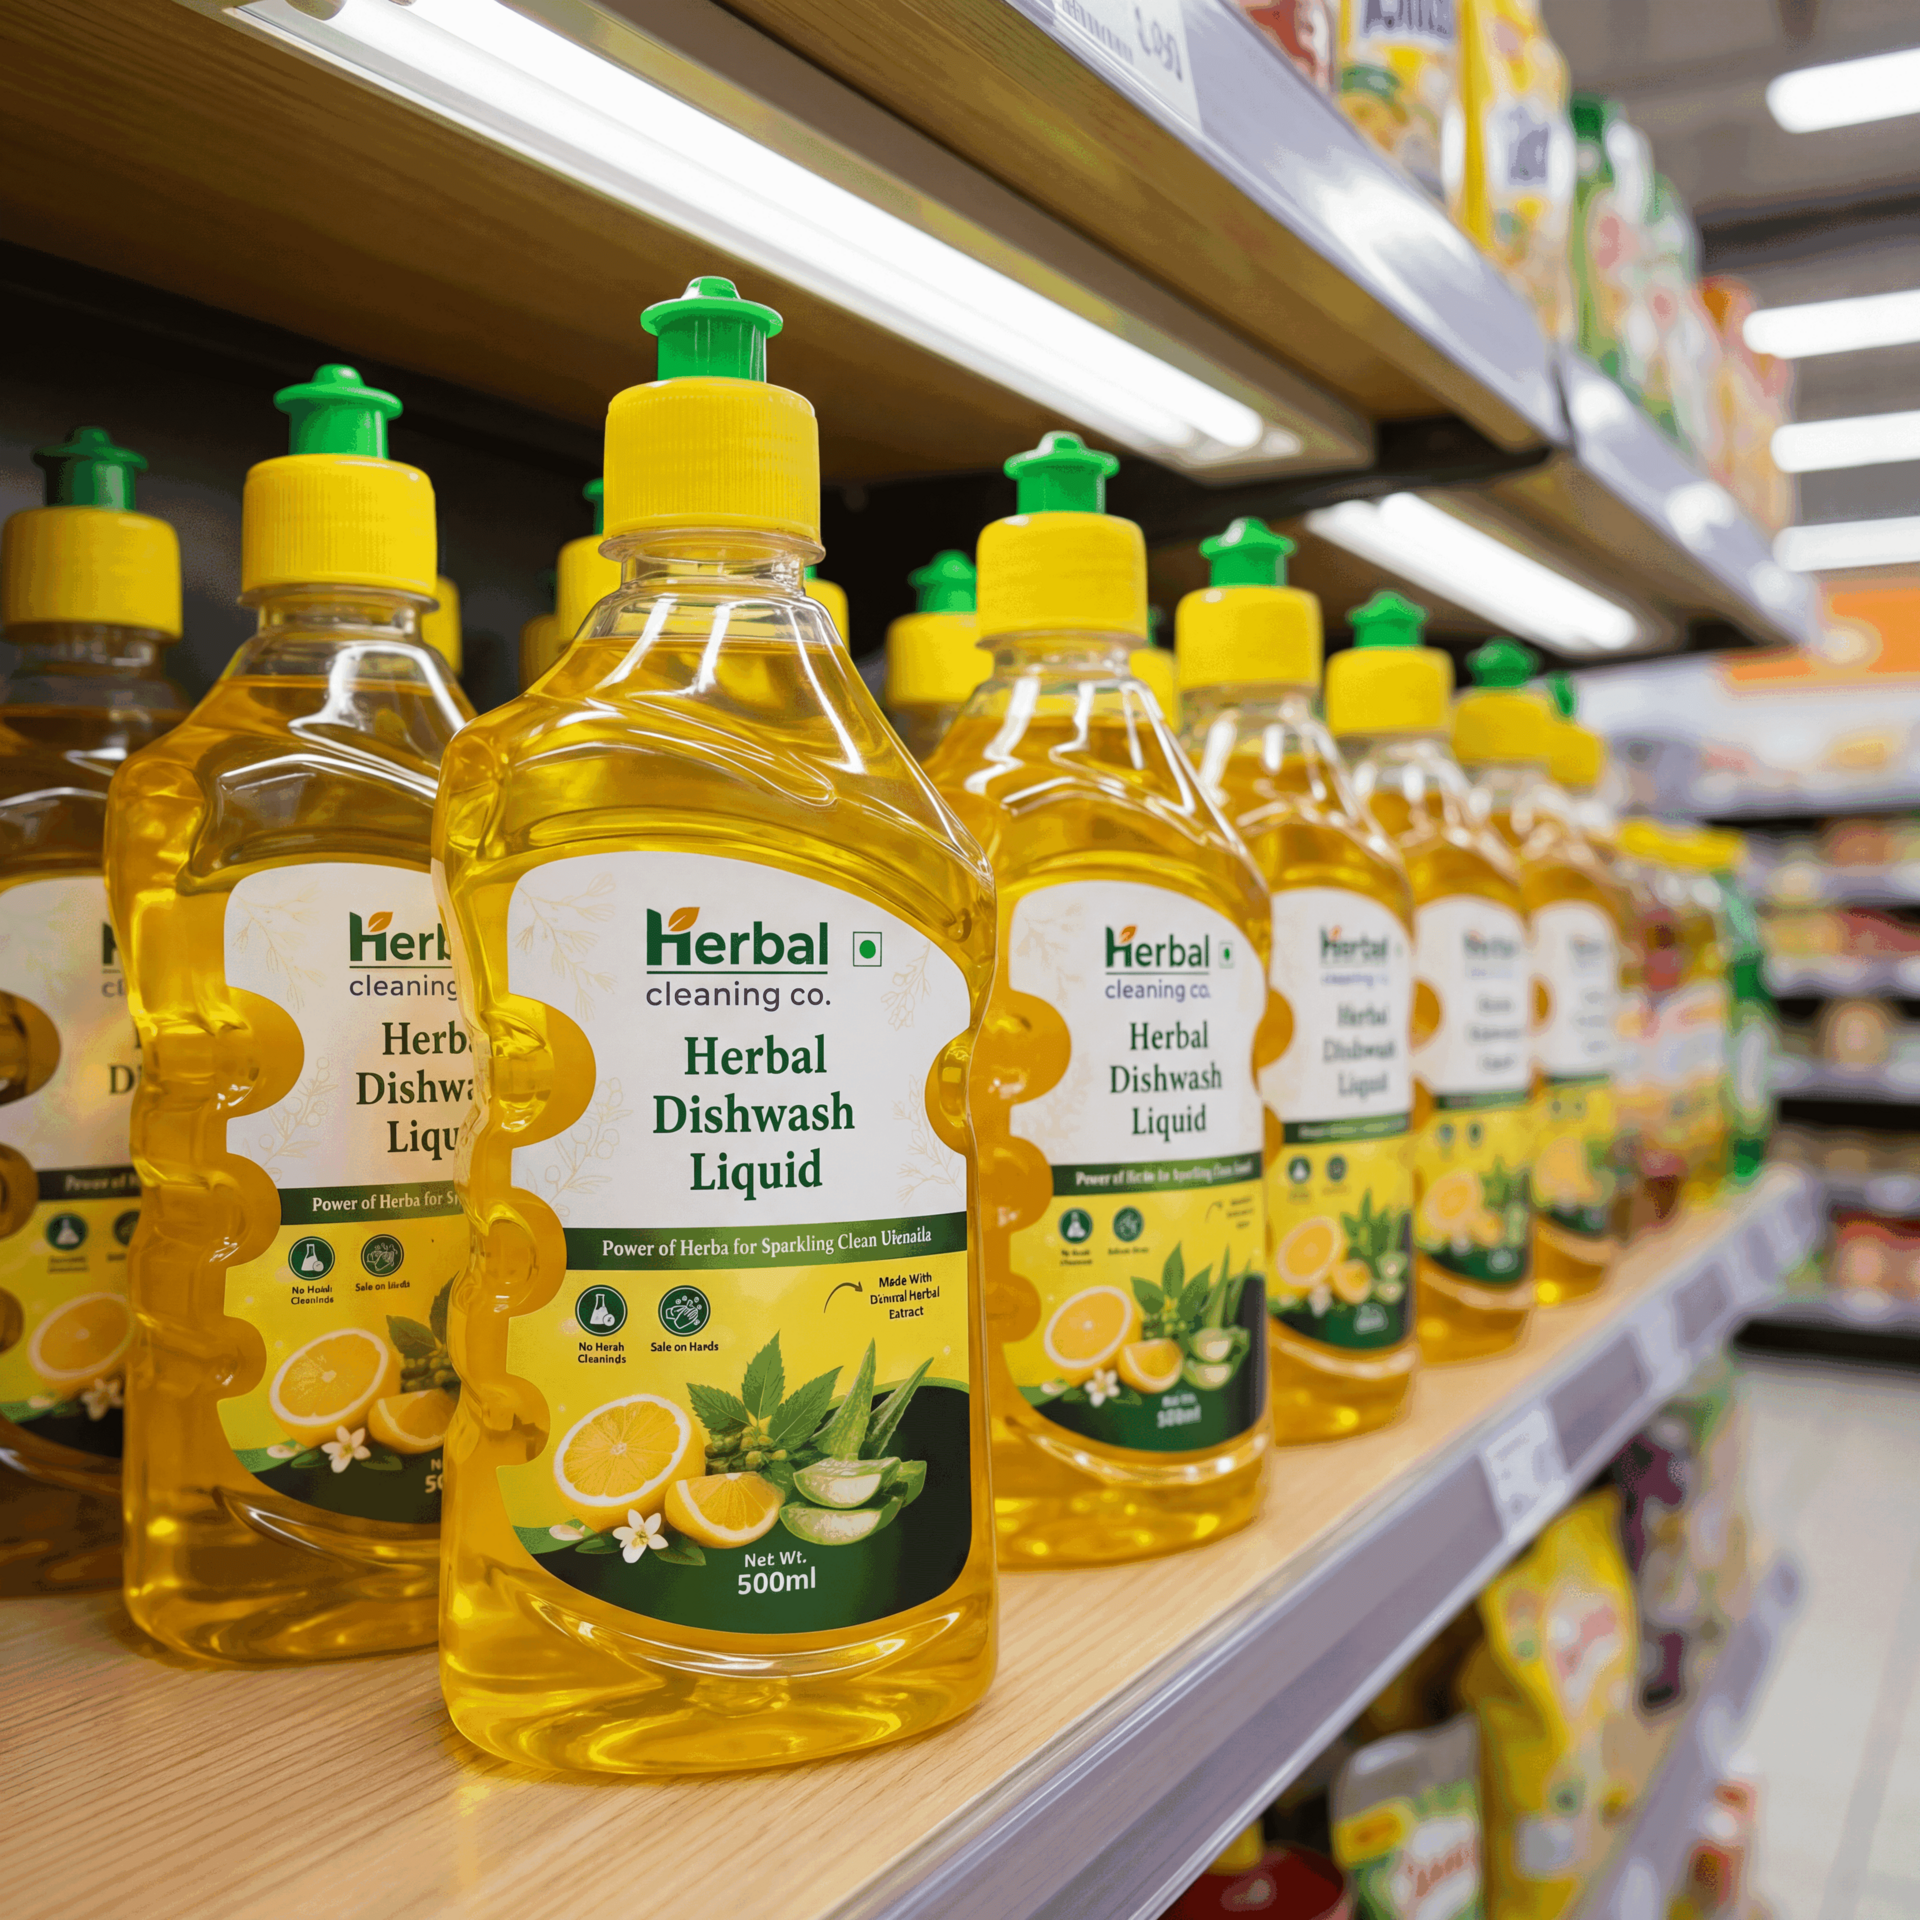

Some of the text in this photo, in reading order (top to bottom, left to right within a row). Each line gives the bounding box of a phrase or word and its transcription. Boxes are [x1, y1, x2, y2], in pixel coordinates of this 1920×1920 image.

[646, 907, 828, 966] Herbal
[1105, 925, 1210, 968] Herbal
[646, 981, 831, 1012] cleaning co.
[1105, 979, 1186, 1002] cleaning
[1129, 1020, 1209, 1051] Herbal
[684, 1034, 827, 1076] Herbal
[1109, 1061, 1222, 1094] Dishwash
[653, 1090, 855, 1134] Dishwash
[1131, 1104, 1207, 1143] Liquid
[690, 1148, 823, 1202] Liquid
[312, 1197, 358, 1212] Power
[361, 1194, 377, 1210] of
[380, 1192, 420, 1209] Herba
[424, 1191, 443, 1206] for
[602, 1239, 655, 1257] Power
[658, 1238, 677, 1256] of
[680, 1238, 729, 1256] Herba
[733, 1237, 757, 1255] for
[761, 1234, 835, 1258] Sparkling
[837, 1232, 877, 1250] Clean
[292, 1286, 305, 1295] No
[909, 1271, 932, 1285] With
[577, 1354, 627, 1365] Cleaninds
[578, 1341, 625, 1352] No Herah
[650, 1341, 672, 1352] Sale
[674, 1343, 687, 1352] on
[744, 1550, 807, 1568] Net Wt.
[737, 1567, 816, 1595] 500ml
